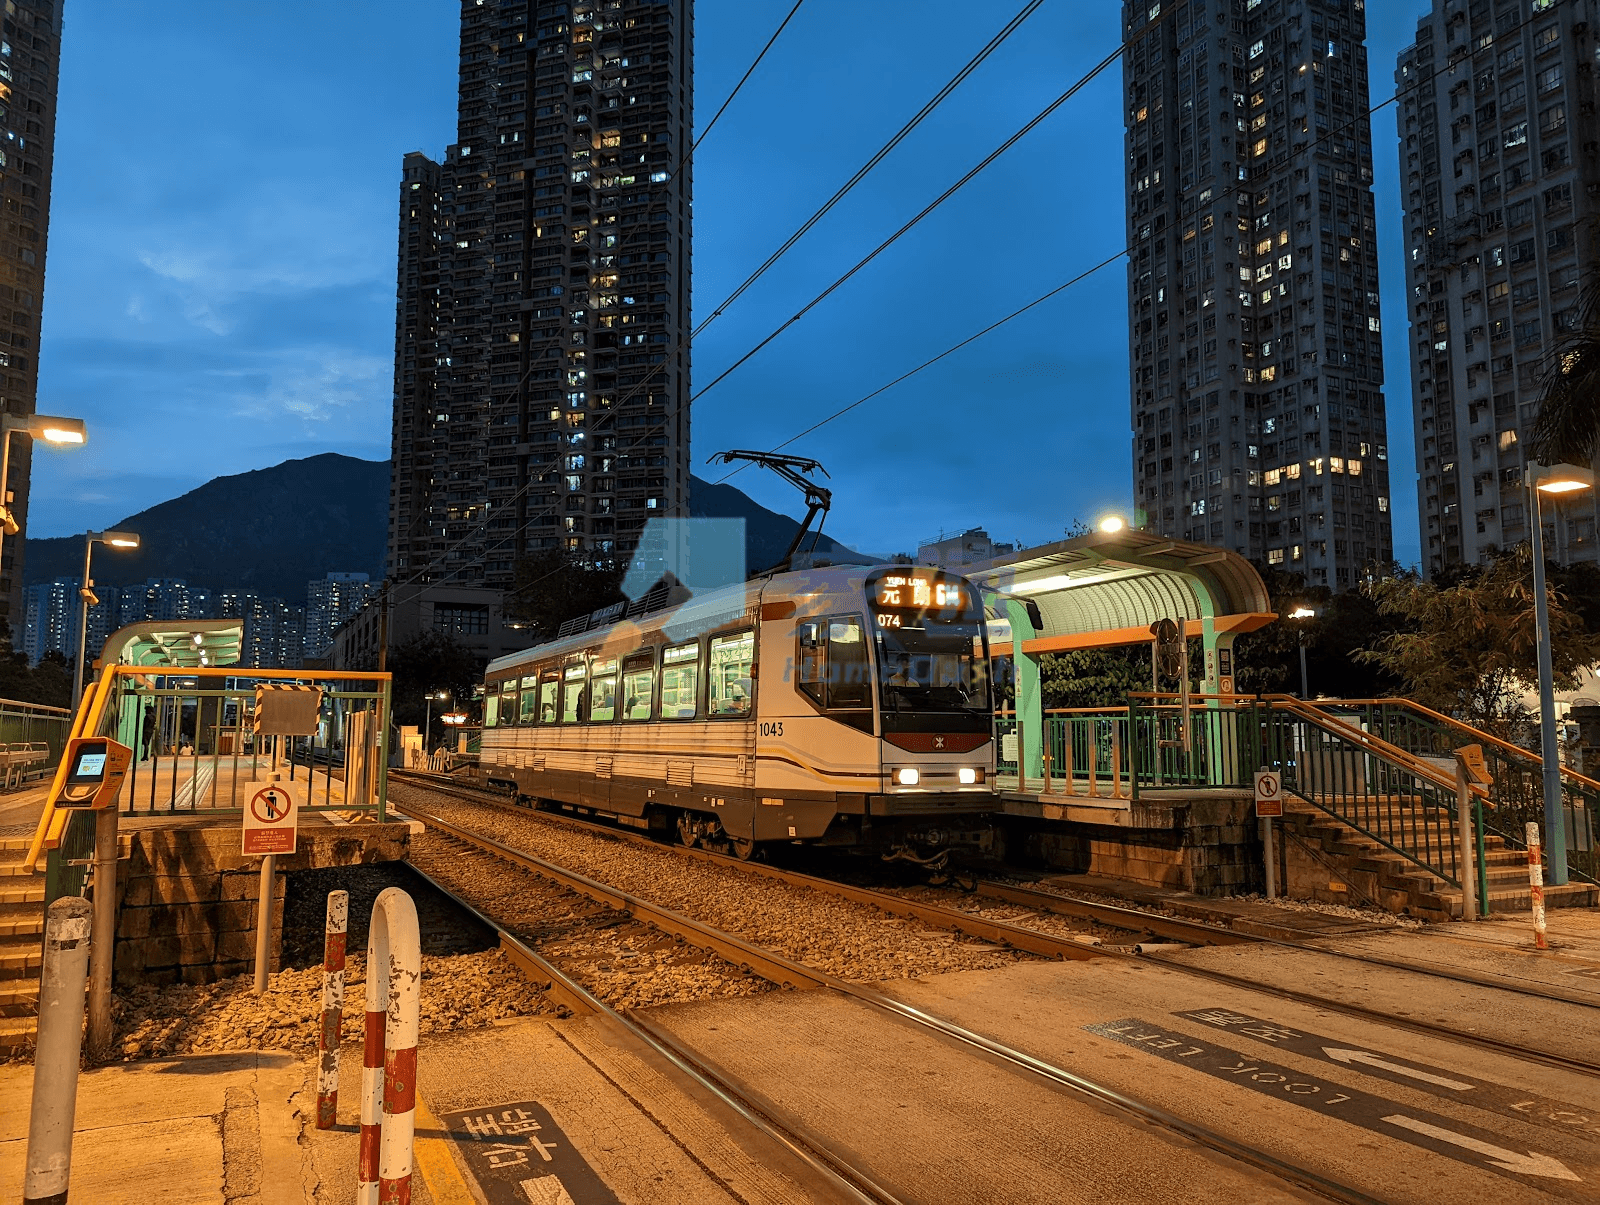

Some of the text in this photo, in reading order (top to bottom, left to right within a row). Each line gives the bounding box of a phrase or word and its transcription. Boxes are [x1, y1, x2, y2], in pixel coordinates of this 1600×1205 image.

[878, 613, 901, 627] 074
[759, 722, 784, 737] 1043
[1106, 1026, 1351, 1106] LOOK LEFT
